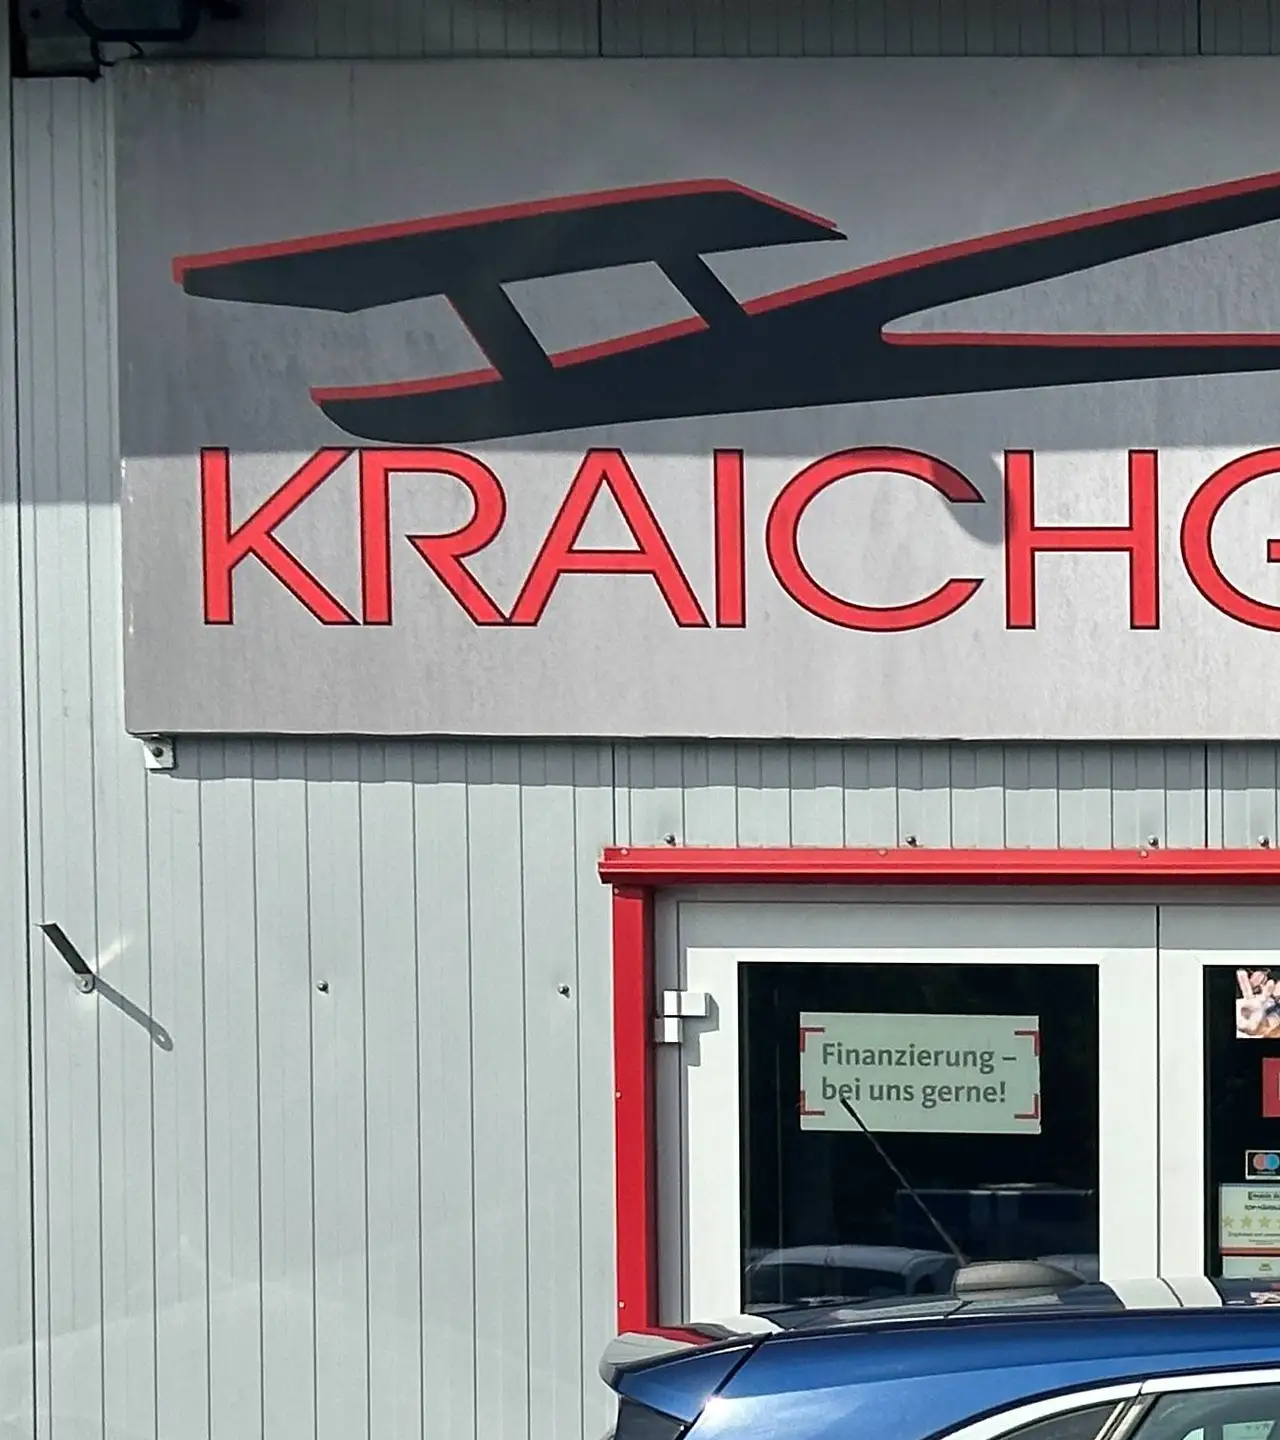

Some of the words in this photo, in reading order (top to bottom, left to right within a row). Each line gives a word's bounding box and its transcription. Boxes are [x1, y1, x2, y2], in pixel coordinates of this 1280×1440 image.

[822, 1043, 996, 1074] Finanzierung
[822, 1077, 861, 1101] bei
[868, 1083, 915, 1101] uns
[922, 1081, 1006, 1109] gerne!
